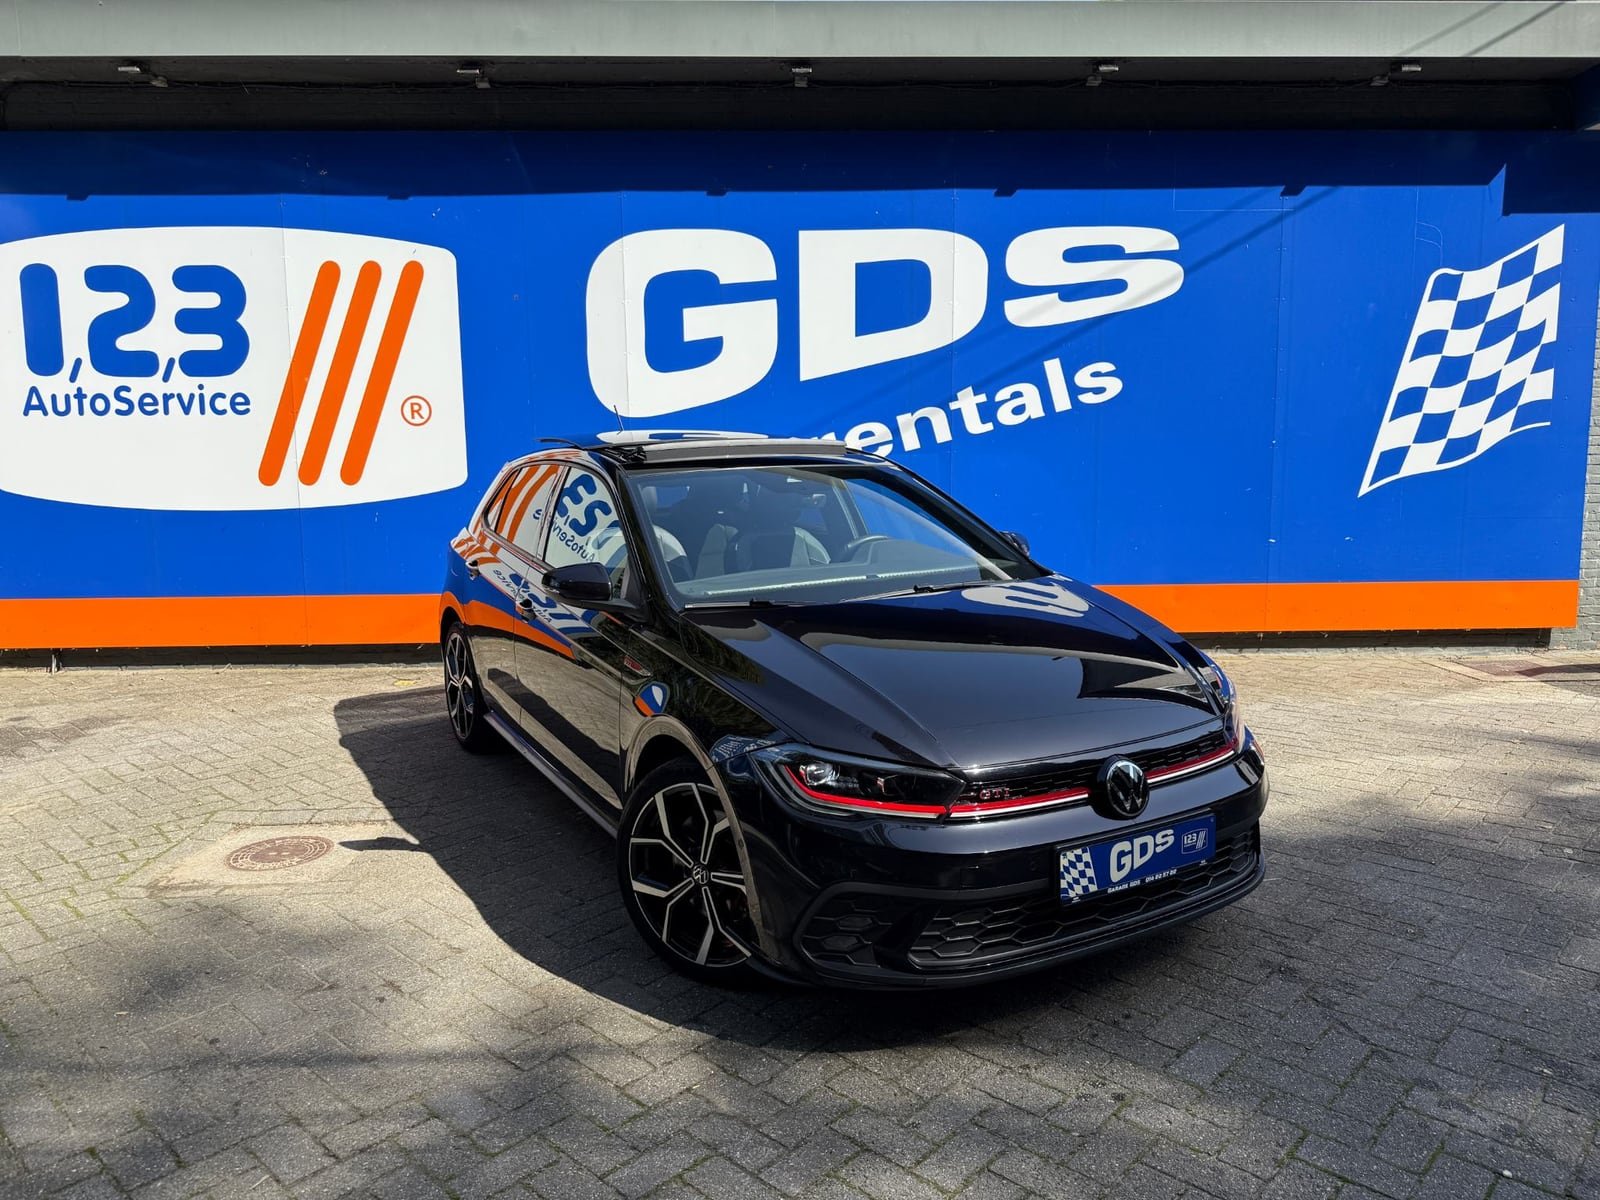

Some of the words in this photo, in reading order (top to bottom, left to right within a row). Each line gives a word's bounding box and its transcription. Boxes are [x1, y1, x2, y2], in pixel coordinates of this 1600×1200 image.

[586, 226, 1184, 418] GDS
[23, 384, 251, 417] AutoService
[790, 357, 1123, 459] entals
[1109, 829, 1175, 883] GDS
